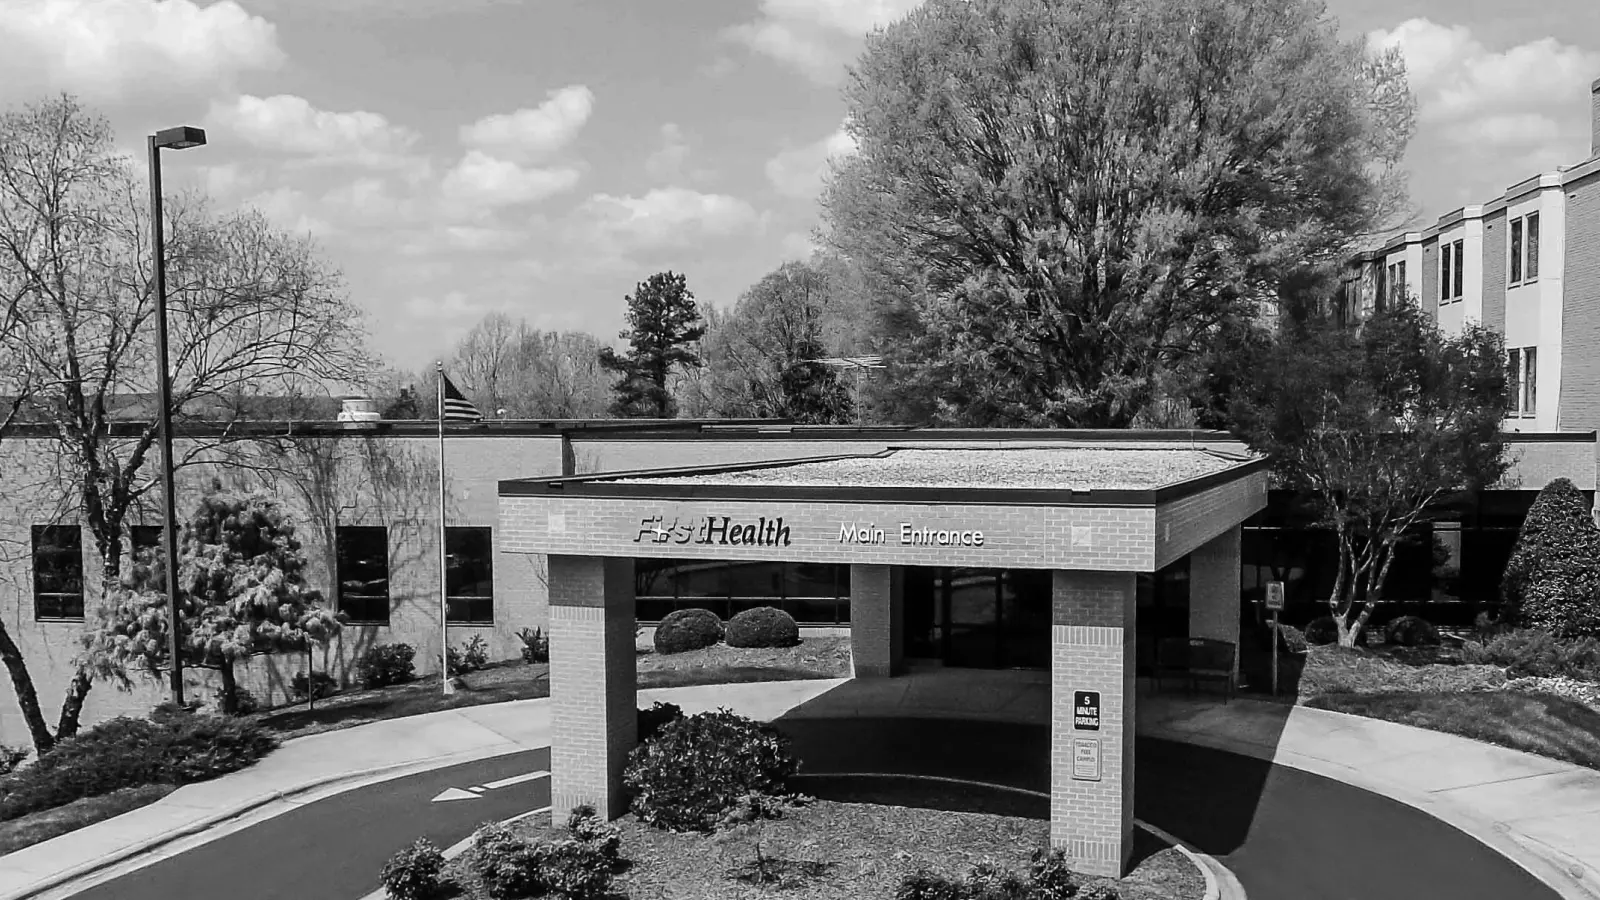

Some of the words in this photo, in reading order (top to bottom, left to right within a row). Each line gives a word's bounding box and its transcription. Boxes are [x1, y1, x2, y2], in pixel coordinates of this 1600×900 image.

[633, 515, 791, 547] FirstHealth
[839, 522, 886, 544] Main
[900, 522, 985, 547] Entrance
[1084, 696, 1091, 705] 5
[1076, 706, 1098, 716] MINUTE
[1075, 716, 1099, 726] PARKING
